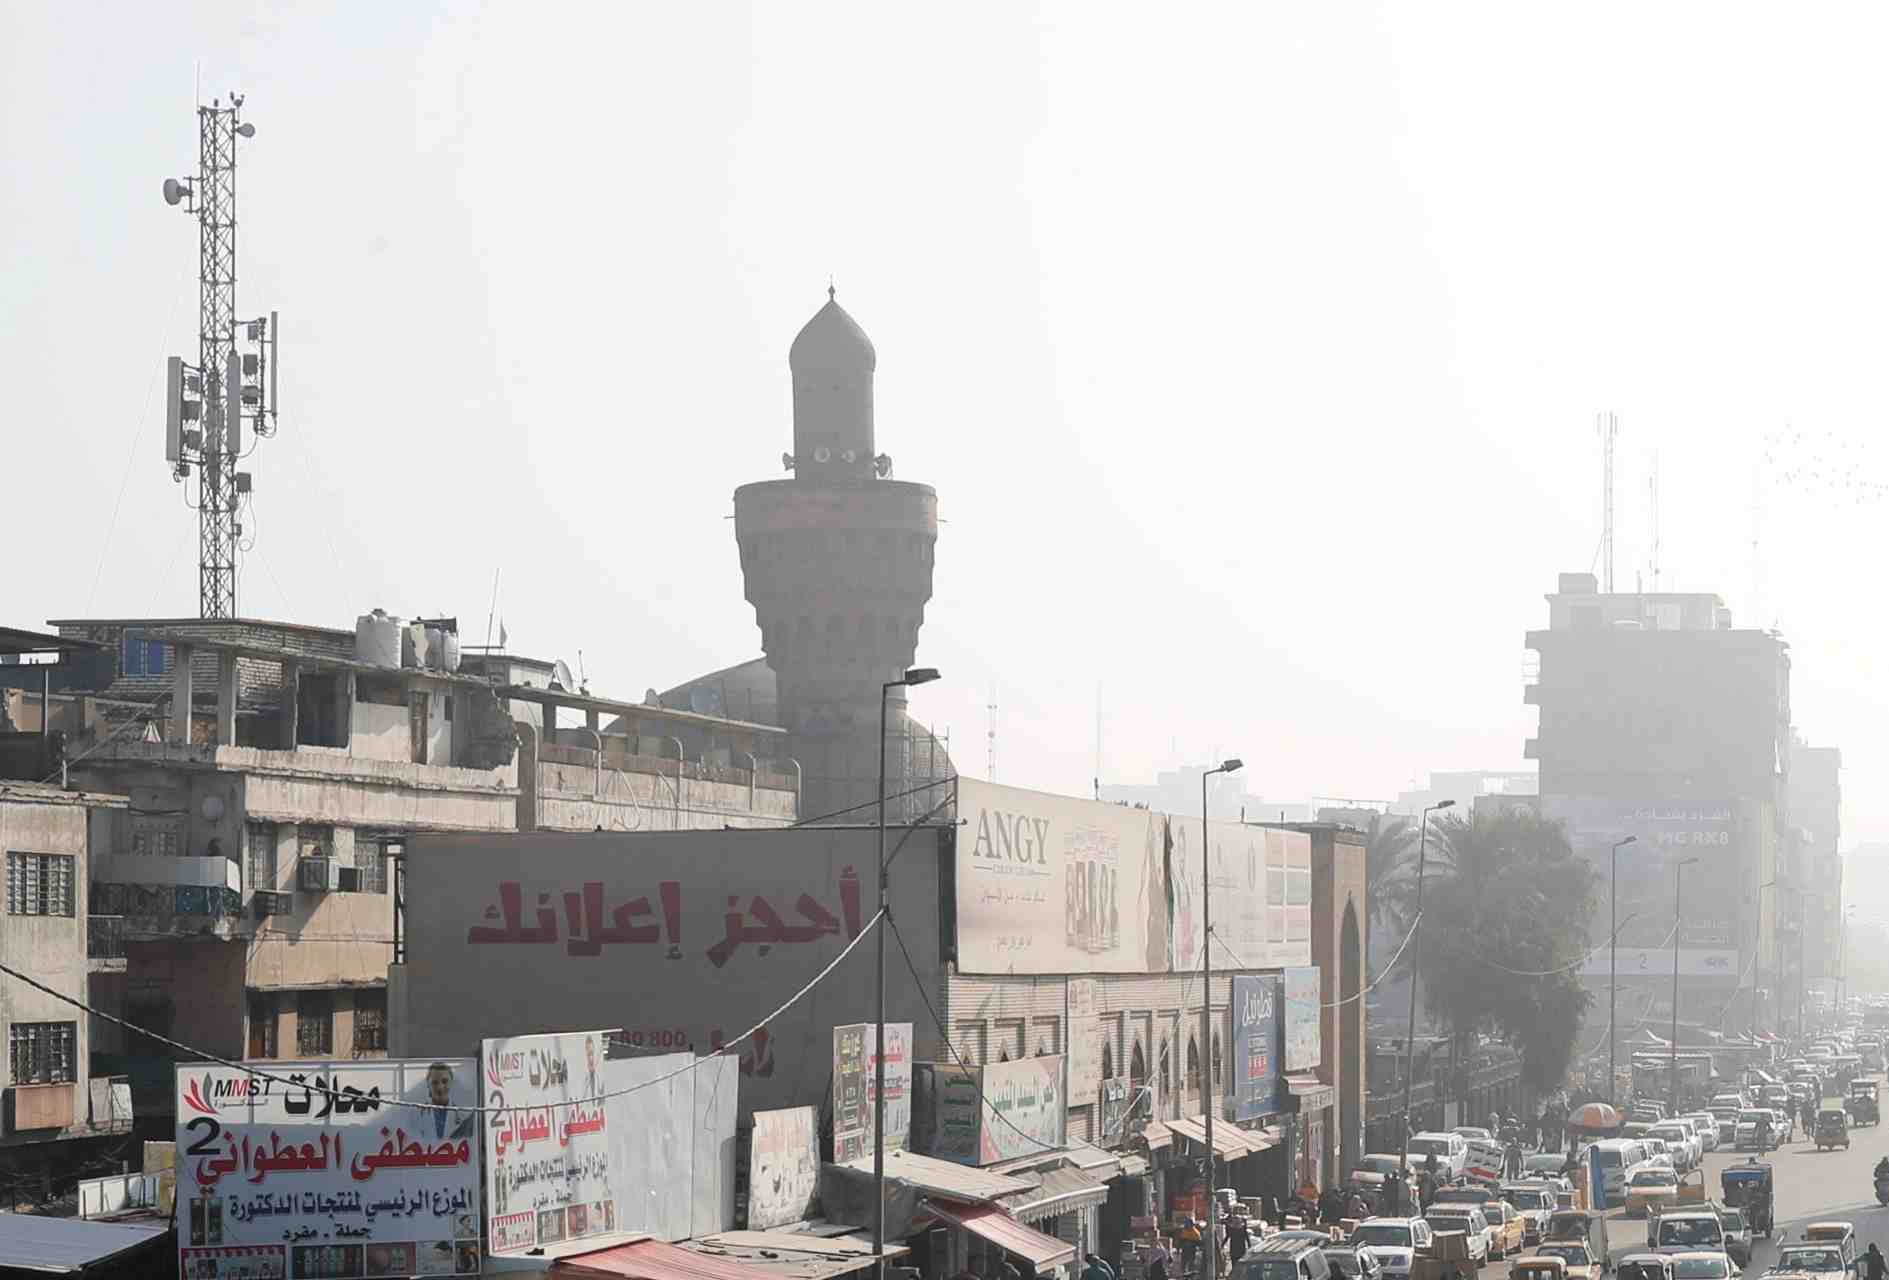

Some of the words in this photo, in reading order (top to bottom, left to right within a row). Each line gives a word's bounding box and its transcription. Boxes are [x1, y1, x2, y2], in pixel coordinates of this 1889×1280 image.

[972, 808, 1050, 865] ANGY
[467, 880, 681, 960] إعلانك
[707, 865, 863, 968] أحجز
[214, 1079, 274, 1097] MMST
[529, 1048, 568, 1090] محلات
[284, 1073, 380, 1118] محلات
[489, 1090, 506, 1129] 2
[185, 1116, 222, 1156] 2
[351, 1126, 471, 1182] مصطفى
[196, 1130, 343, 1194] العطواني
[229, 1193, 299, 1223] الدكتورة
[302, 1191, 363, 1220] لمنتجات
[365, 1188, 430, 1223] الرئيسي
[431, 1188, 473, 1217] الموزع
[281, 1226, 319, 1243] مفرد
[334, 1223, 373, 1241] جملة
